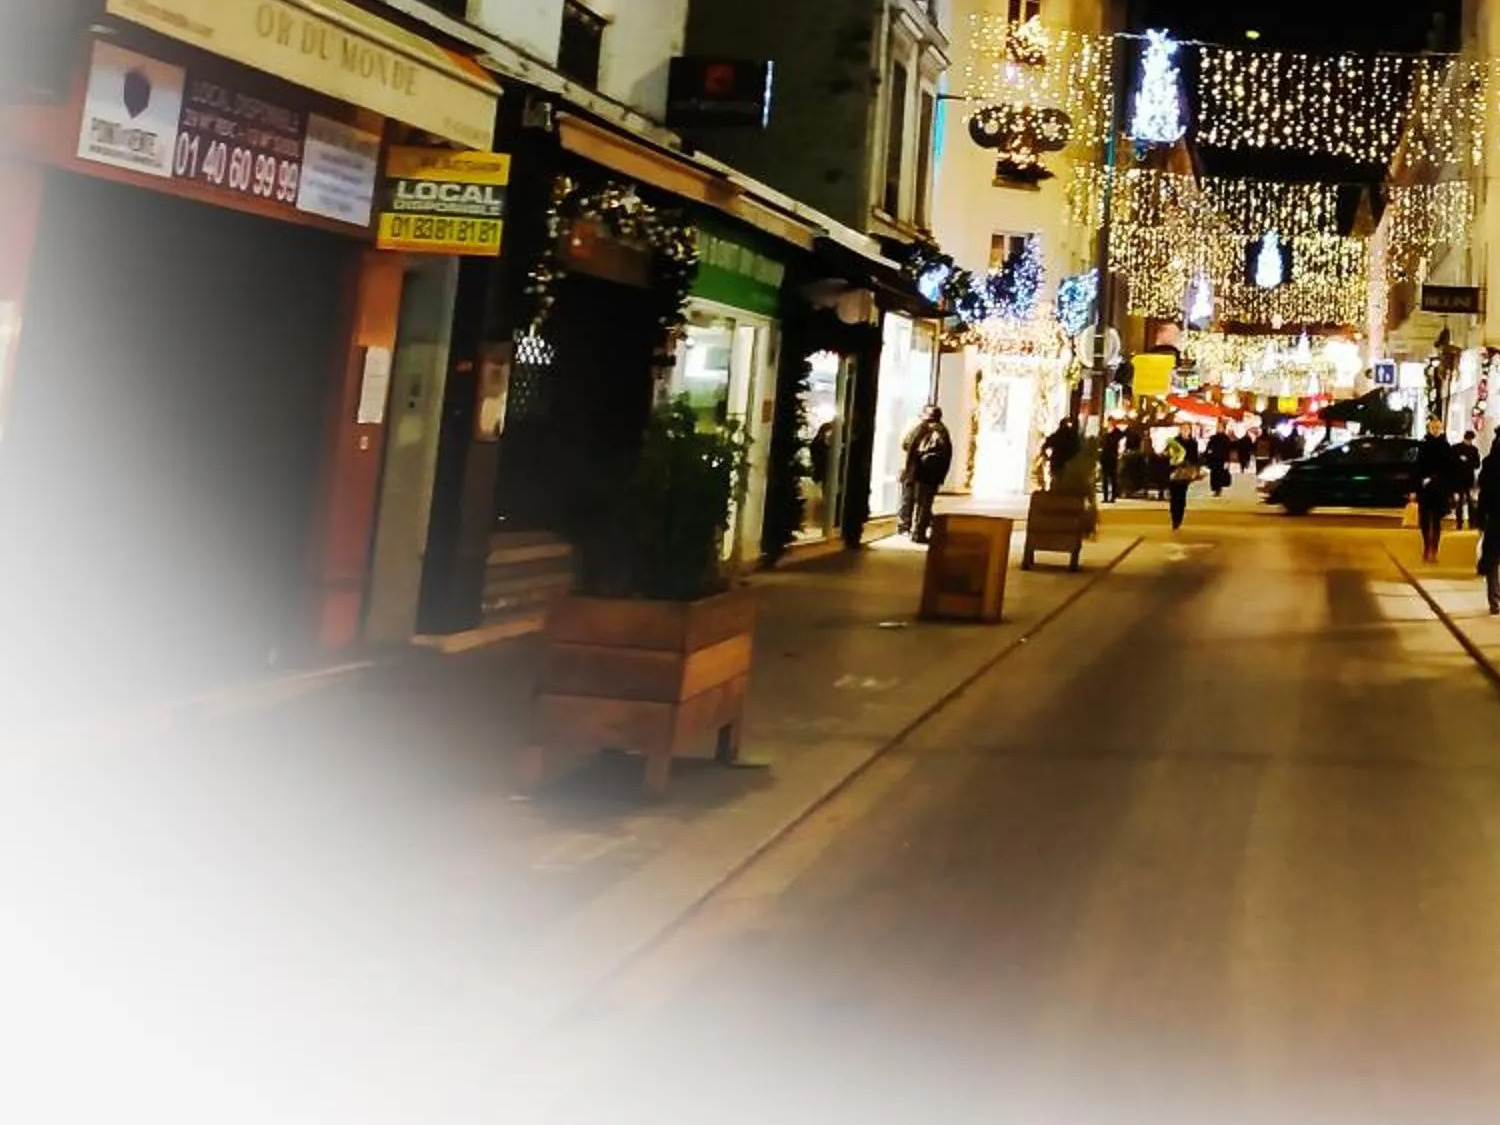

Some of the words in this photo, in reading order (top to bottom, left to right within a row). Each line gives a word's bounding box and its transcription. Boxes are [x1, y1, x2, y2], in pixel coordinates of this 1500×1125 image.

[255, 2, 294, 46] OR
[300, 24, 330, 61] DU
[339, 35, 420, 97] MONDE
[175, 131, 200, 178] 01
[201, 139, 228, 185] 40
[229, 146, 252, 191] 60
[252, 153, 275, 198] 99
[276, 160, 299, 203] 99
[396, 180, 502, 205] LOCAL
